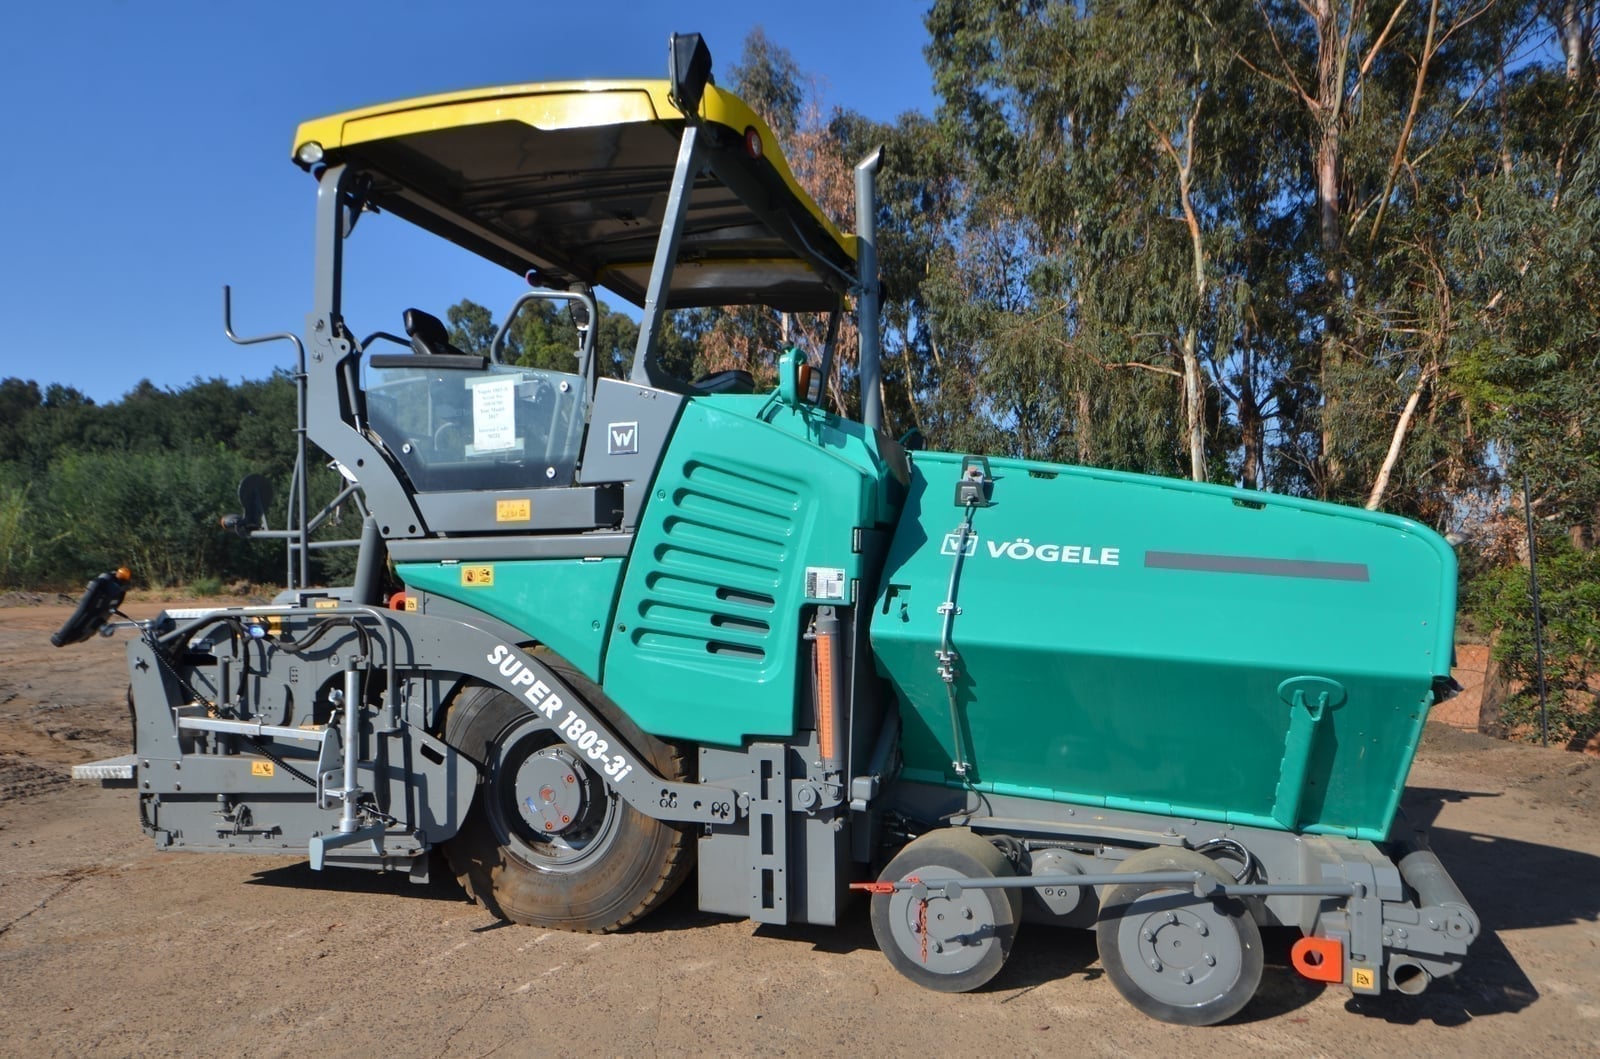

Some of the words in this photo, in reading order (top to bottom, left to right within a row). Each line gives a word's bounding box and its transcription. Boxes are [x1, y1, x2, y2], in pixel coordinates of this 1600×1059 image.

[612, 429, 634, 447] W
[987, 538, 1120, 566] VÖGELE
[487, 645, 563, 720] SUPER
[558, 710, 633, 783] 1803-3i
